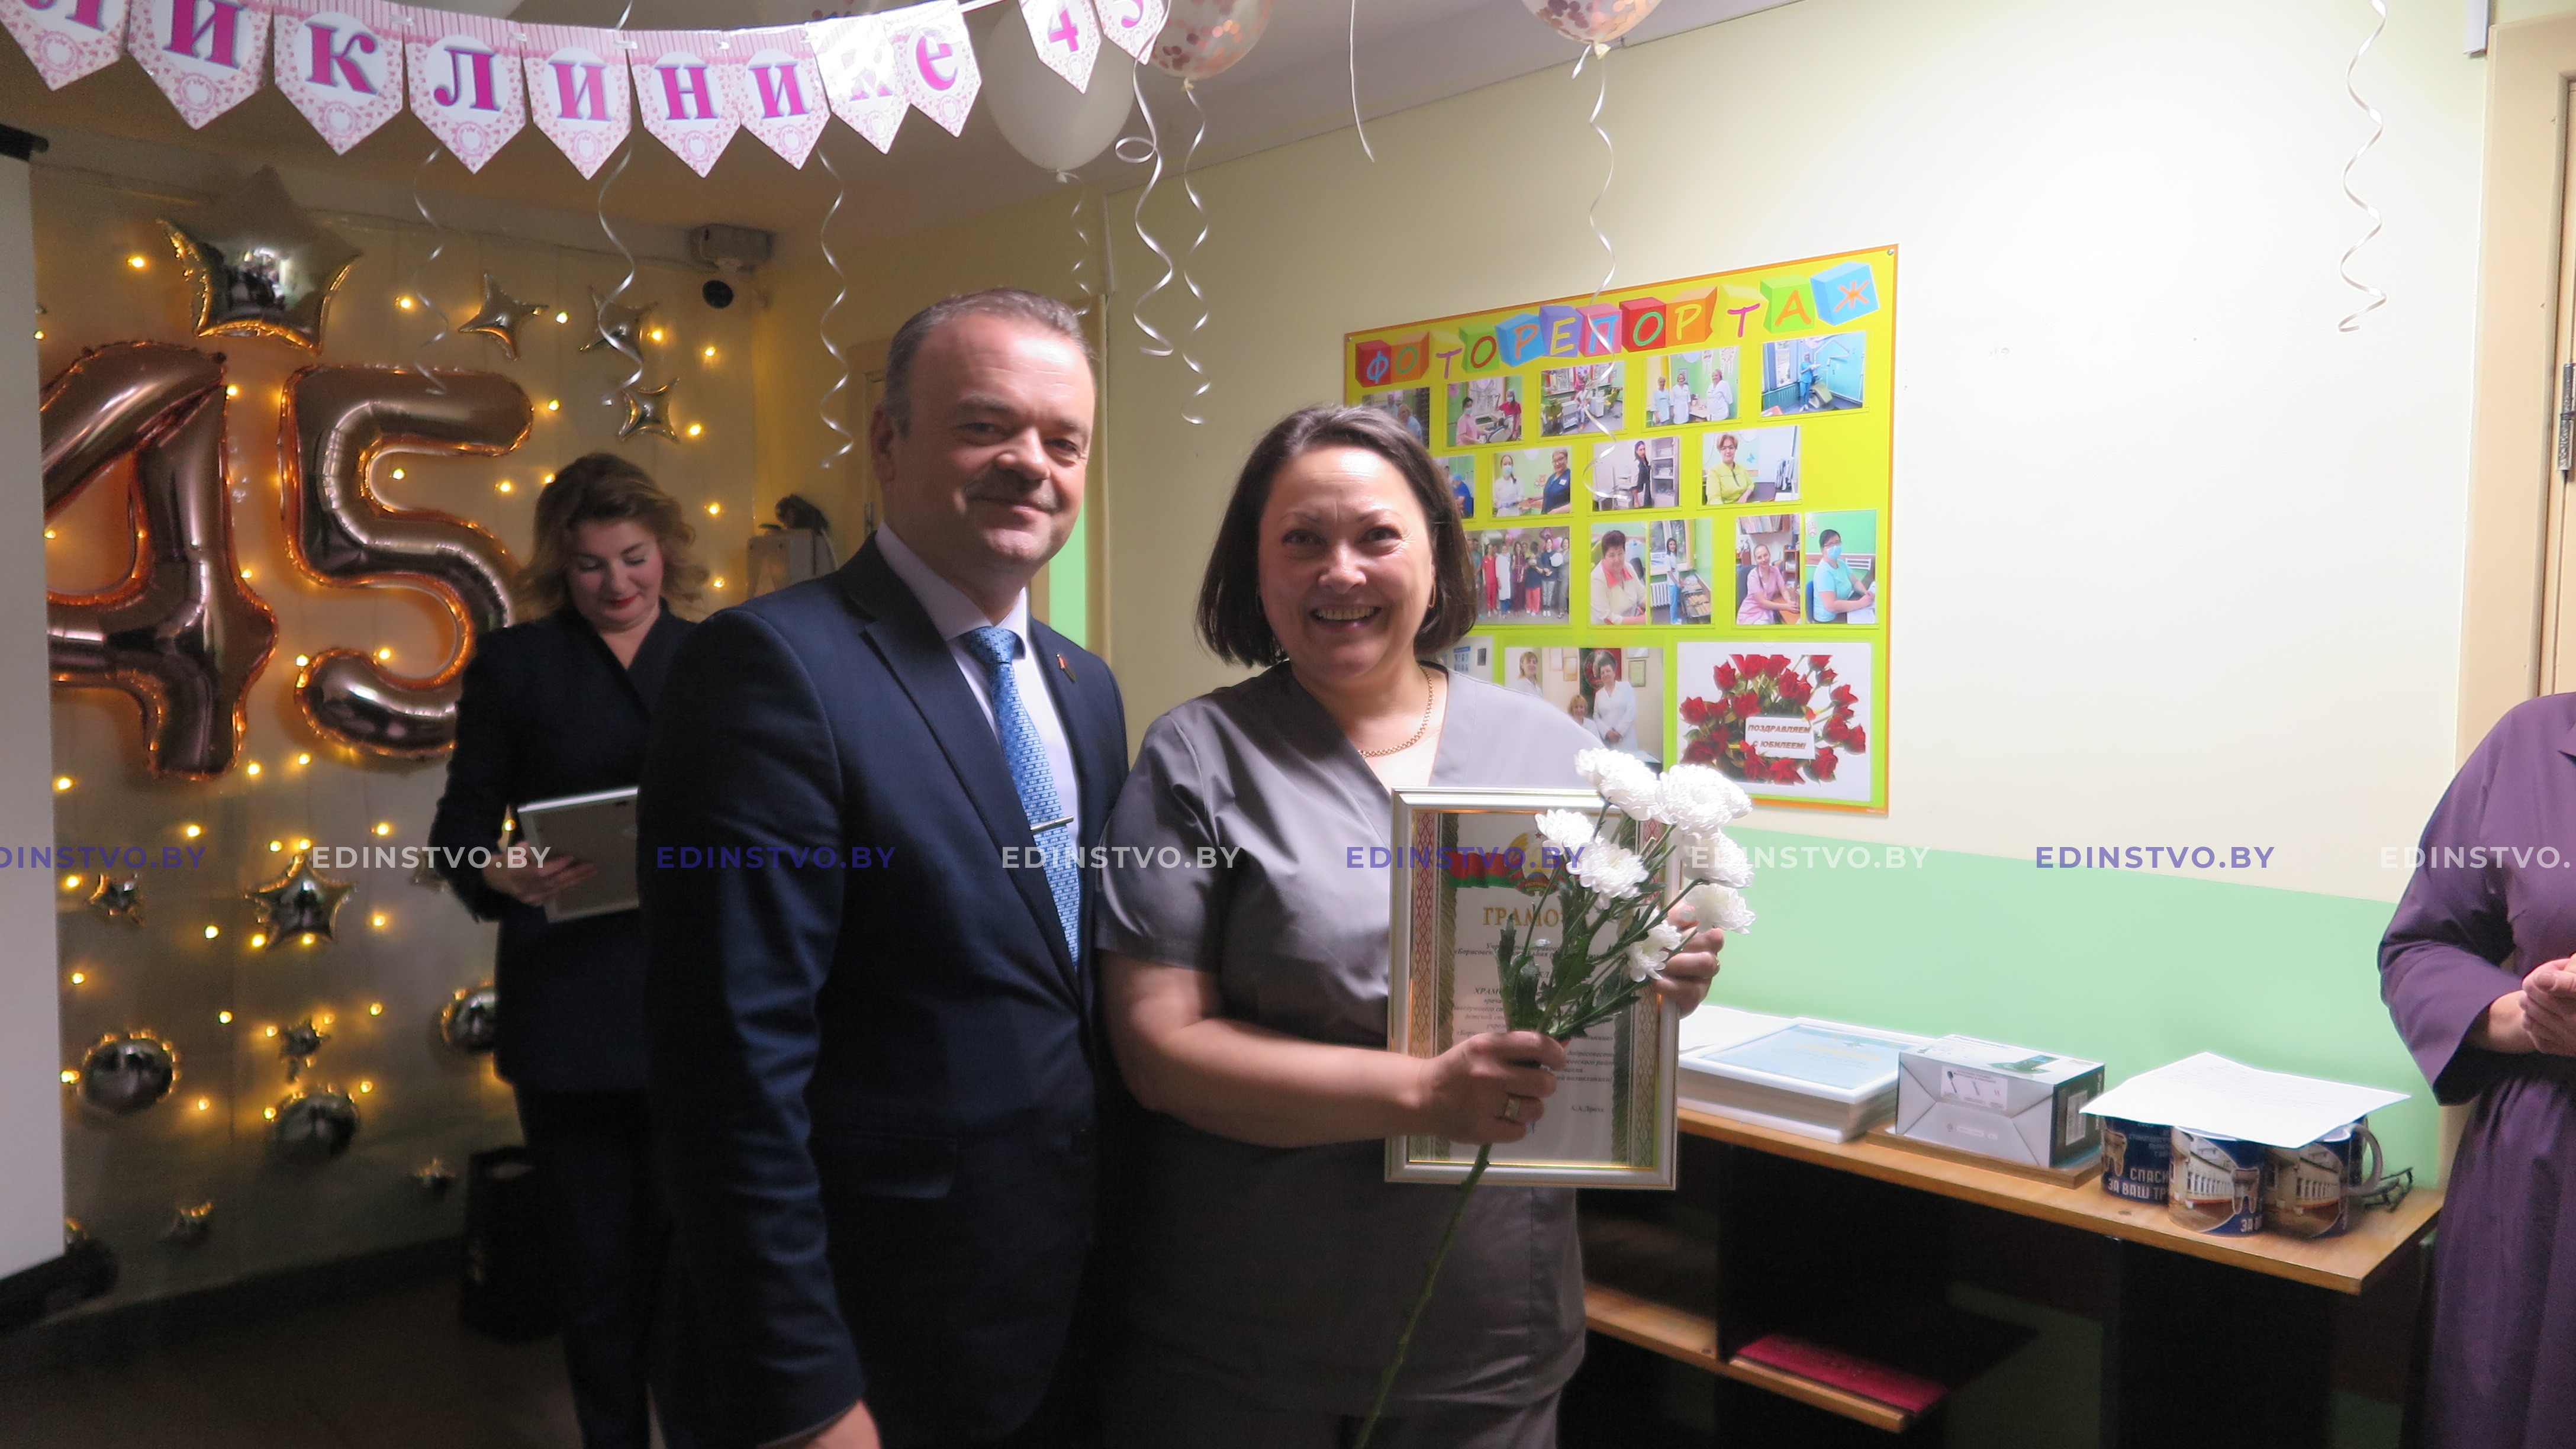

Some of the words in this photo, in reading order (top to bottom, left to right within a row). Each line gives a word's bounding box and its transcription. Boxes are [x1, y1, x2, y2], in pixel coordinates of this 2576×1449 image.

[1366, 279, 1870, 385] ФОТОРЕПОРТАЖ
[41, 340, 534, 781] 45
[1747, 724, 1811, 734] ПОЗДРАВЛЯЕМ
[1482, 907, 1563, 928] ГРАМО
[2108, 1178, 2119, 1192] ЗА
[2122, 1183, 2150, 1199] ВАШ
